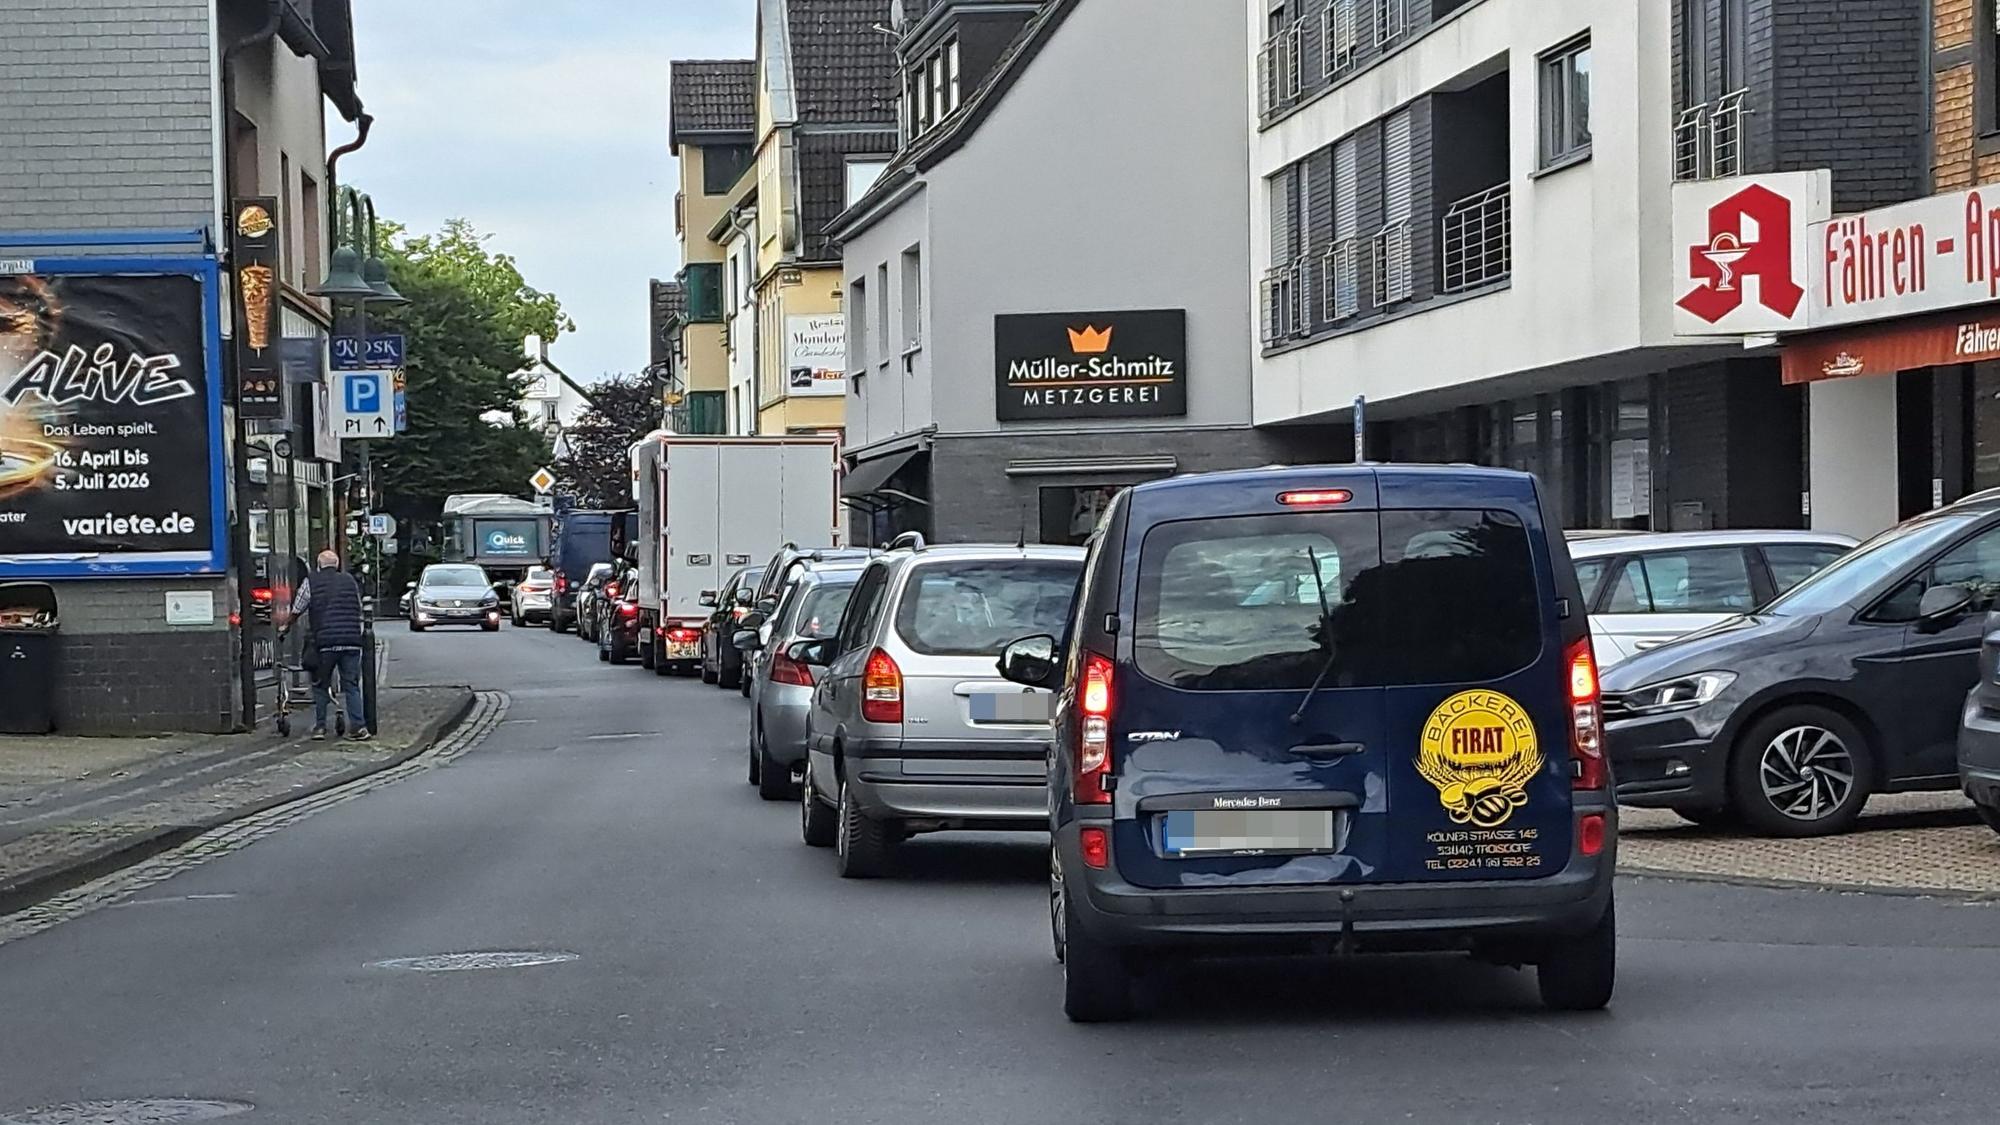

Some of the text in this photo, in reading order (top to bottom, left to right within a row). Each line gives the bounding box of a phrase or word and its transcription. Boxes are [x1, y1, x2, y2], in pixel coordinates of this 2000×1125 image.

[1825, 217, 1926, 307] Fähren
[1008, 355, 1174, 380] Müller-Schmitz
[352, 378, 376, 410] P
[1023, 386, 1159, 405] METZGEREI
[44, 424, 70, 436] Das
[73, 423, 114, 436] Leben
[345, 419, 361, 433] P1
[54, 449, 149, 469] 16. April bis
[55, 473, 150, 490] 5. Juli 2026
[63, 512, 195, 535] variete.de
[493, 534, 525, 545] Quick
[1428, 694, 1531, 742] BÄCKEREI
[1128, 730, 1181, 741] CITAN
[1452, 727, 1505, 755] FIRAT
